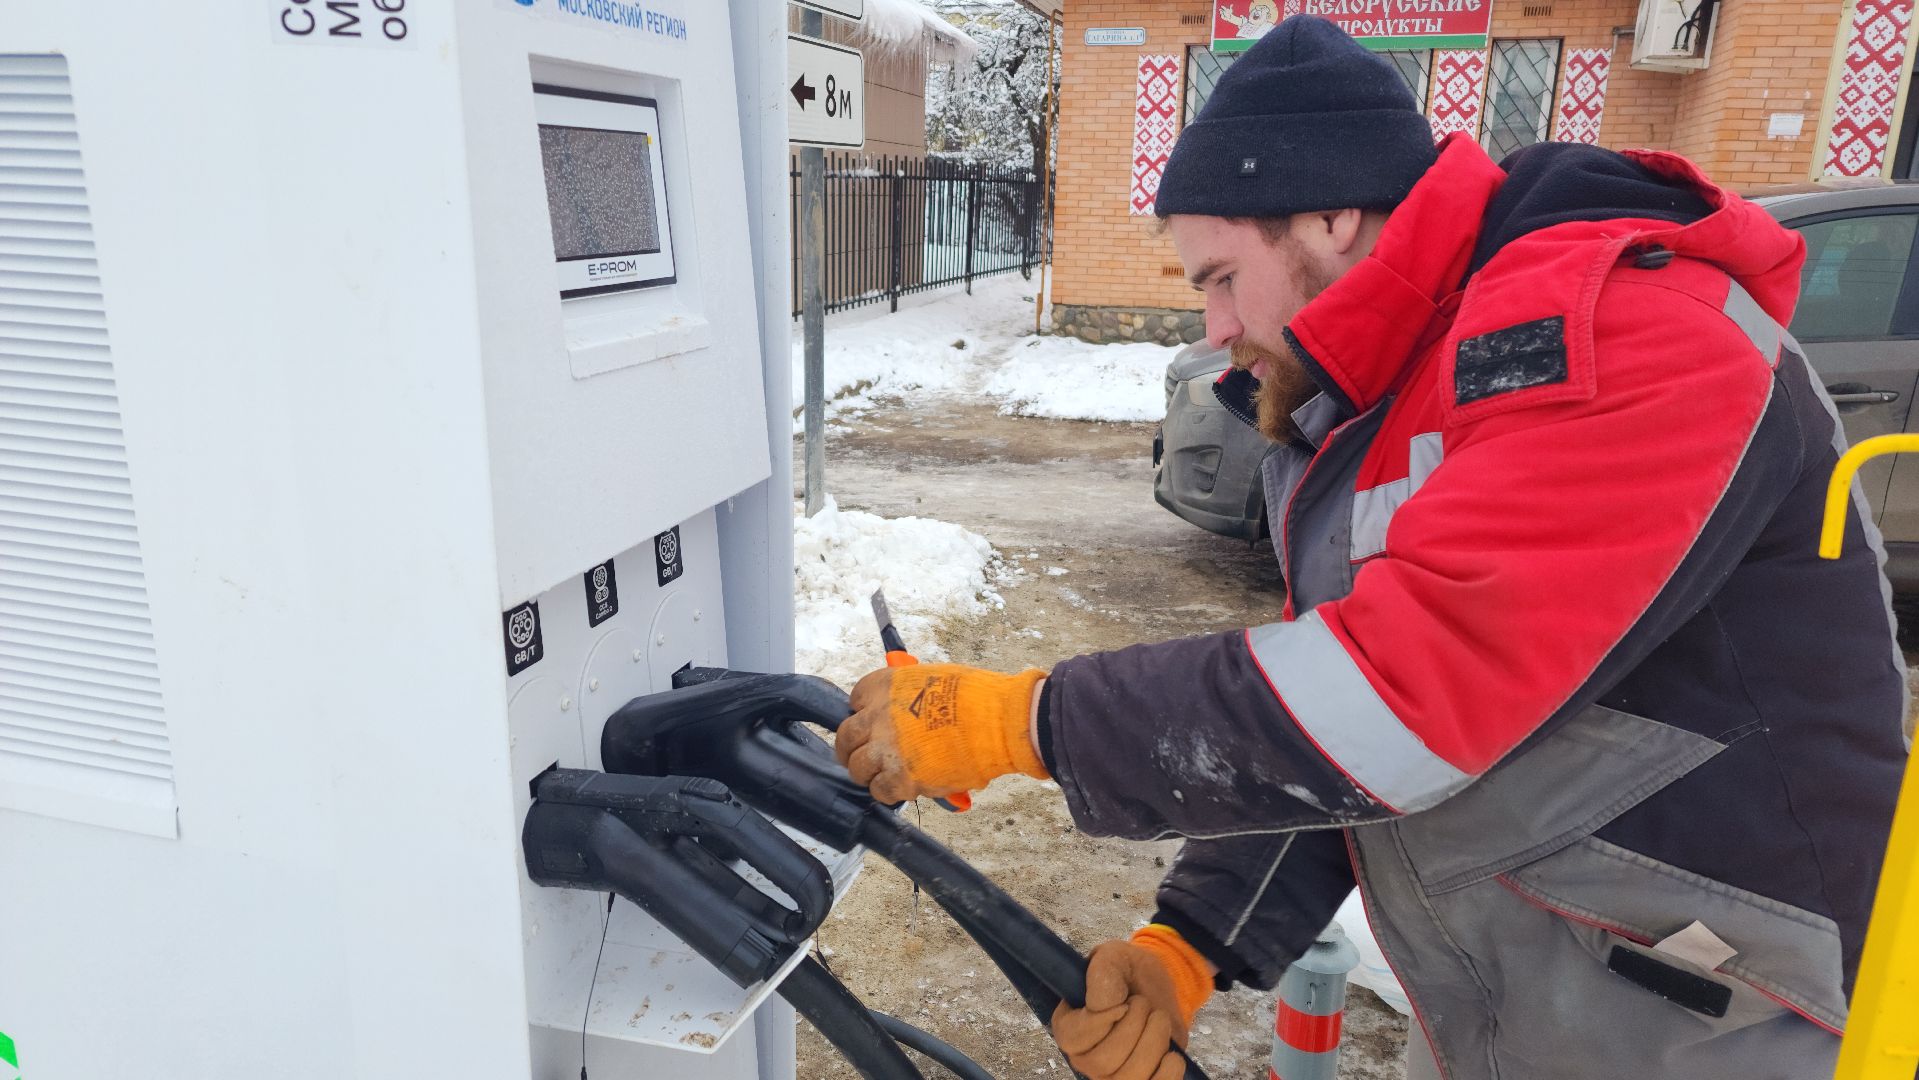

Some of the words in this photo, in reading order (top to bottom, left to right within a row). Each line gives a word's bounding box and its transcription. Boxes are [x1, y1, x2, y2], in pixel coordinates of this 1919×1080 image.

[646, 11, 687, 41] РЕГИОН
[1337, 18, 1443, 37] ПРОДУКТЫ
[663, 562, 677, 578] GB/T
[514, 644, 536, 665] GB/T
